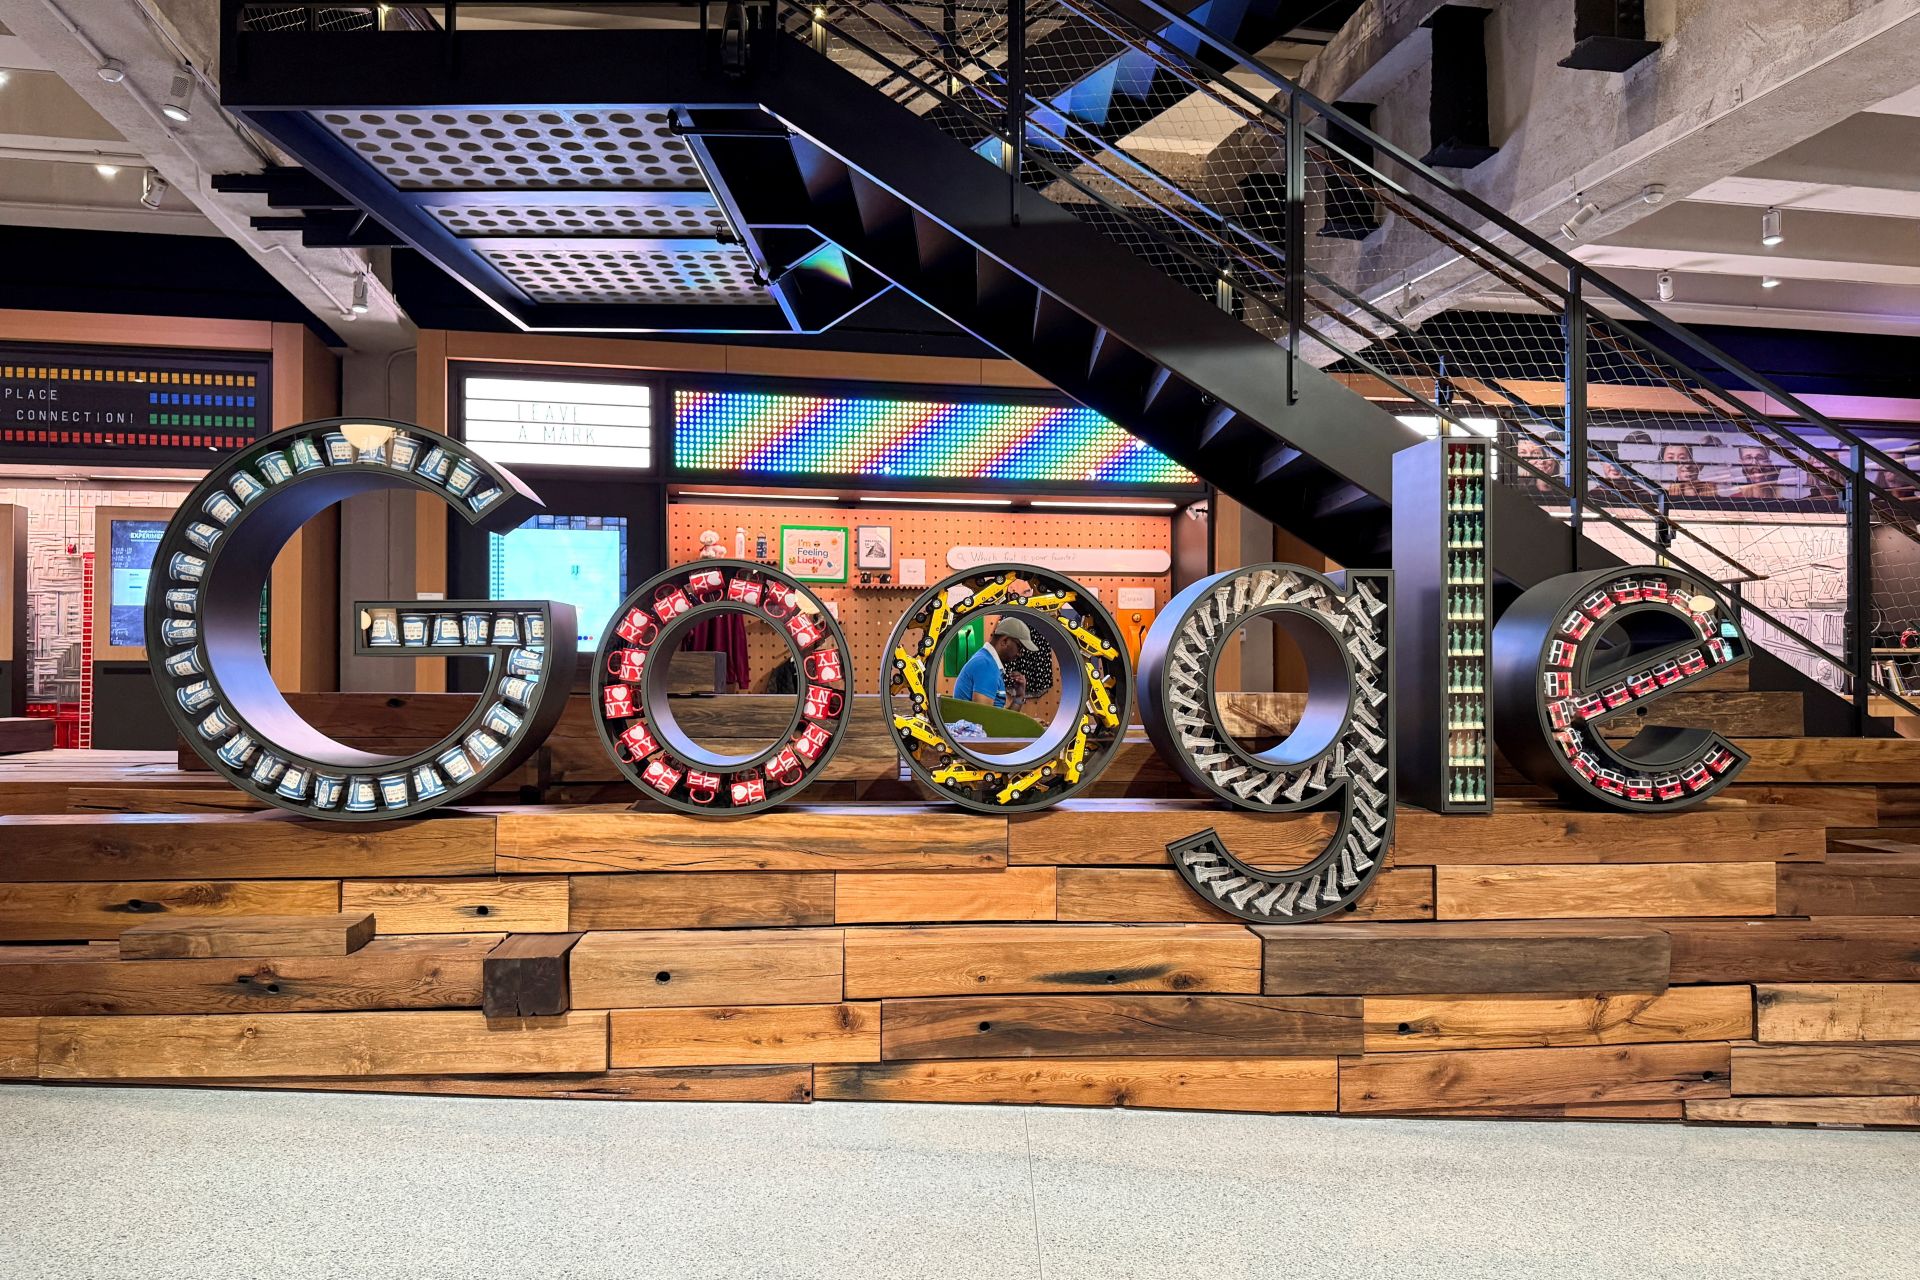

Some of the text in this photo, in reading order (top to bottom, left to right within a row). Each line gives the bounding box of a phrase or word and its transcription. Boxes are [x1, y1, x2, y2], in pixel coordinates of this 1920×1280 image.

[5, 388, 58, 400] PLACE
[16, 409, 133, 424] CONNECTION!
[518, 403, 580, 422] LEAVE
[518, 425, 595, 444] A MARK
[797, 547, 829, 559] Feeling
[797, 556, 823, 566] Lucky
[623, 651, 630, 664] I
[145, 416, 1753, 923] Google
[620, 665, 644, 680] NY
[605, 688, 613, 702] I
[806, 687, 830, 704] NY
[605, 701, 631, 717] NY
[622, 733, 634, 746] I
[803, 726, 828, 746] NY
[629, 736, 655, 759] NY
[655, 768, 678, 793] NY
